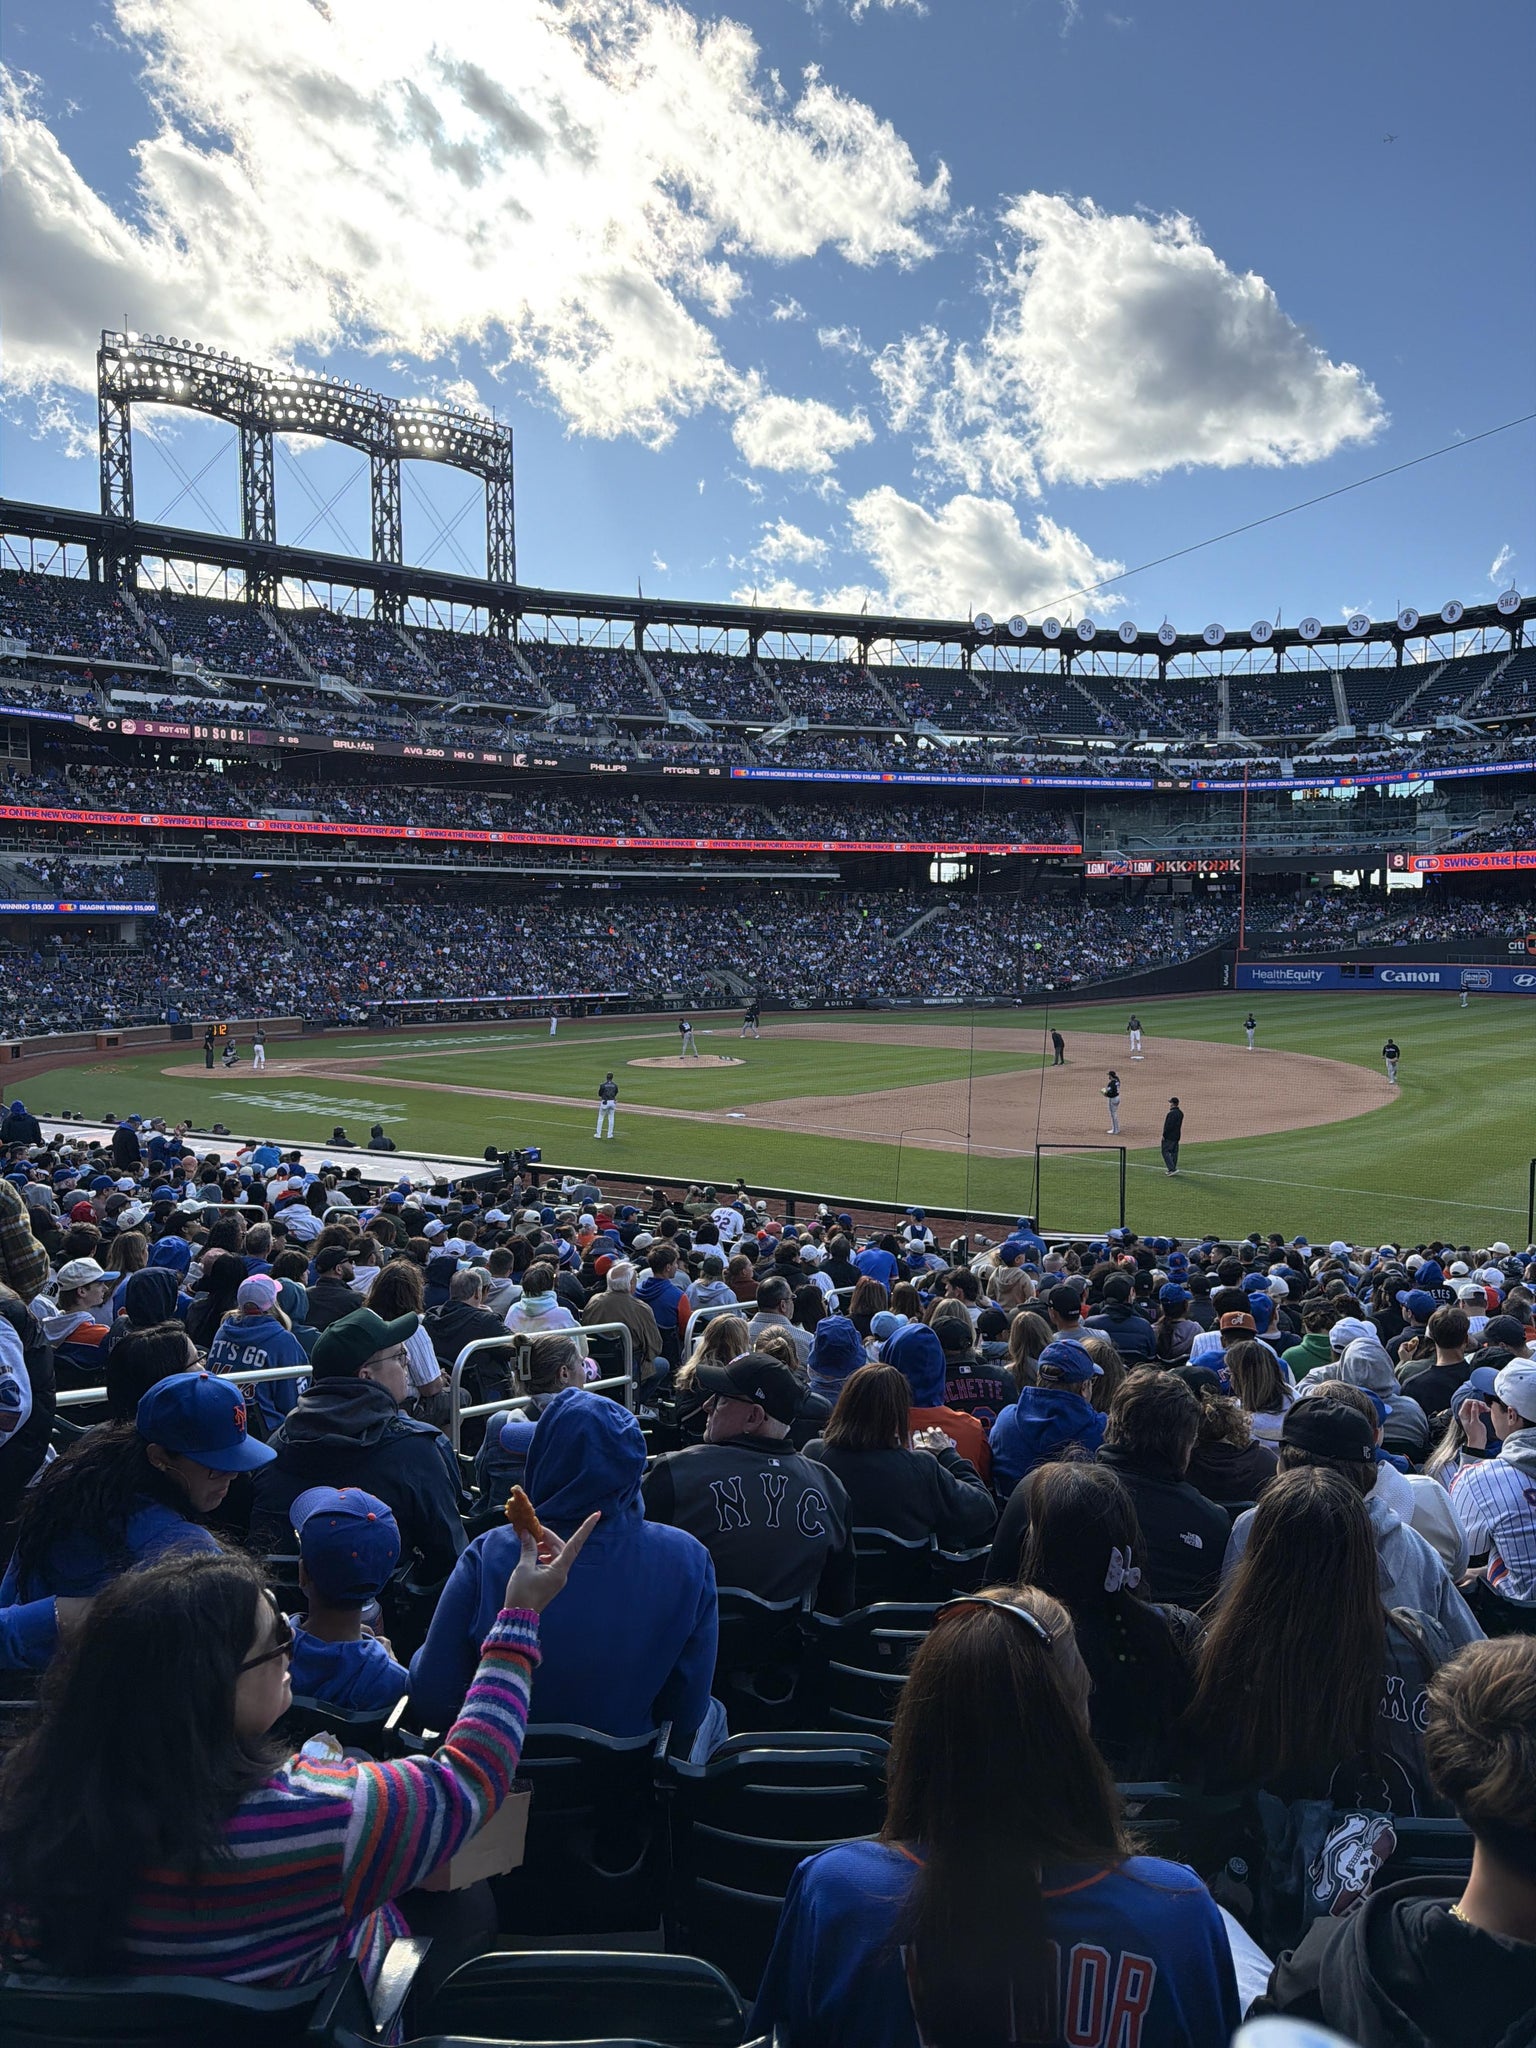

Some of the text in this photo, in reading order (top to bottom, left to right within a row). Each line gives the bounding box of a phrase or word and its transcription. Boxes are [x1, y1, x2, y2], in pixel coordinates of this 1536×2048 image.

[1013, 620, 1022, 631] 18
[1047, 623, 1056, 633] 16
[1080, 624, 1092, 635] 24
[1305, 623, 1315, 633] 14
[1352, 621, 1366, 631] 37
[1124, 628, 1132, 638] 17
[1162, 630, 1172, 640] 36
[1209, 629, 1219, 640] 31
[1256, 626, 1266, 637] 41
[107, 720, 117, 729] 0
[159, 725, 173, 733] BOT
[174, 726, 189, 734] 4TH
[404, 747, 445, 757] AVG .250
[590, 763, 627, 772] PHILLIPS
[663, 767, 700, 775] PITCHES
[85, 813, 117, 822] LOTTERY
[216, 819, 244, 827] FENCES
[360, 826, 388, 834] LOTTERY
[1393, 854, 1404, 866] 8
[1444, 857, 1481, 868] SWING
[1482, 856, 1489, 865] 4
[1490, 855, 1512, 865] THE
[1087, 862, 1104, 873] LGM
[1134, 862, 1152, 873] LGM
[1508, 940, 1525, 950] citi
[1252, 969, 1322, 982] HealthEquity
[1381, 970, 1440, 982] Canon
[242, 1346, 268, 1368] GO
[709, 1472, 826, 1538] NYC
[1046, 1938, 1158, 2048] OR
